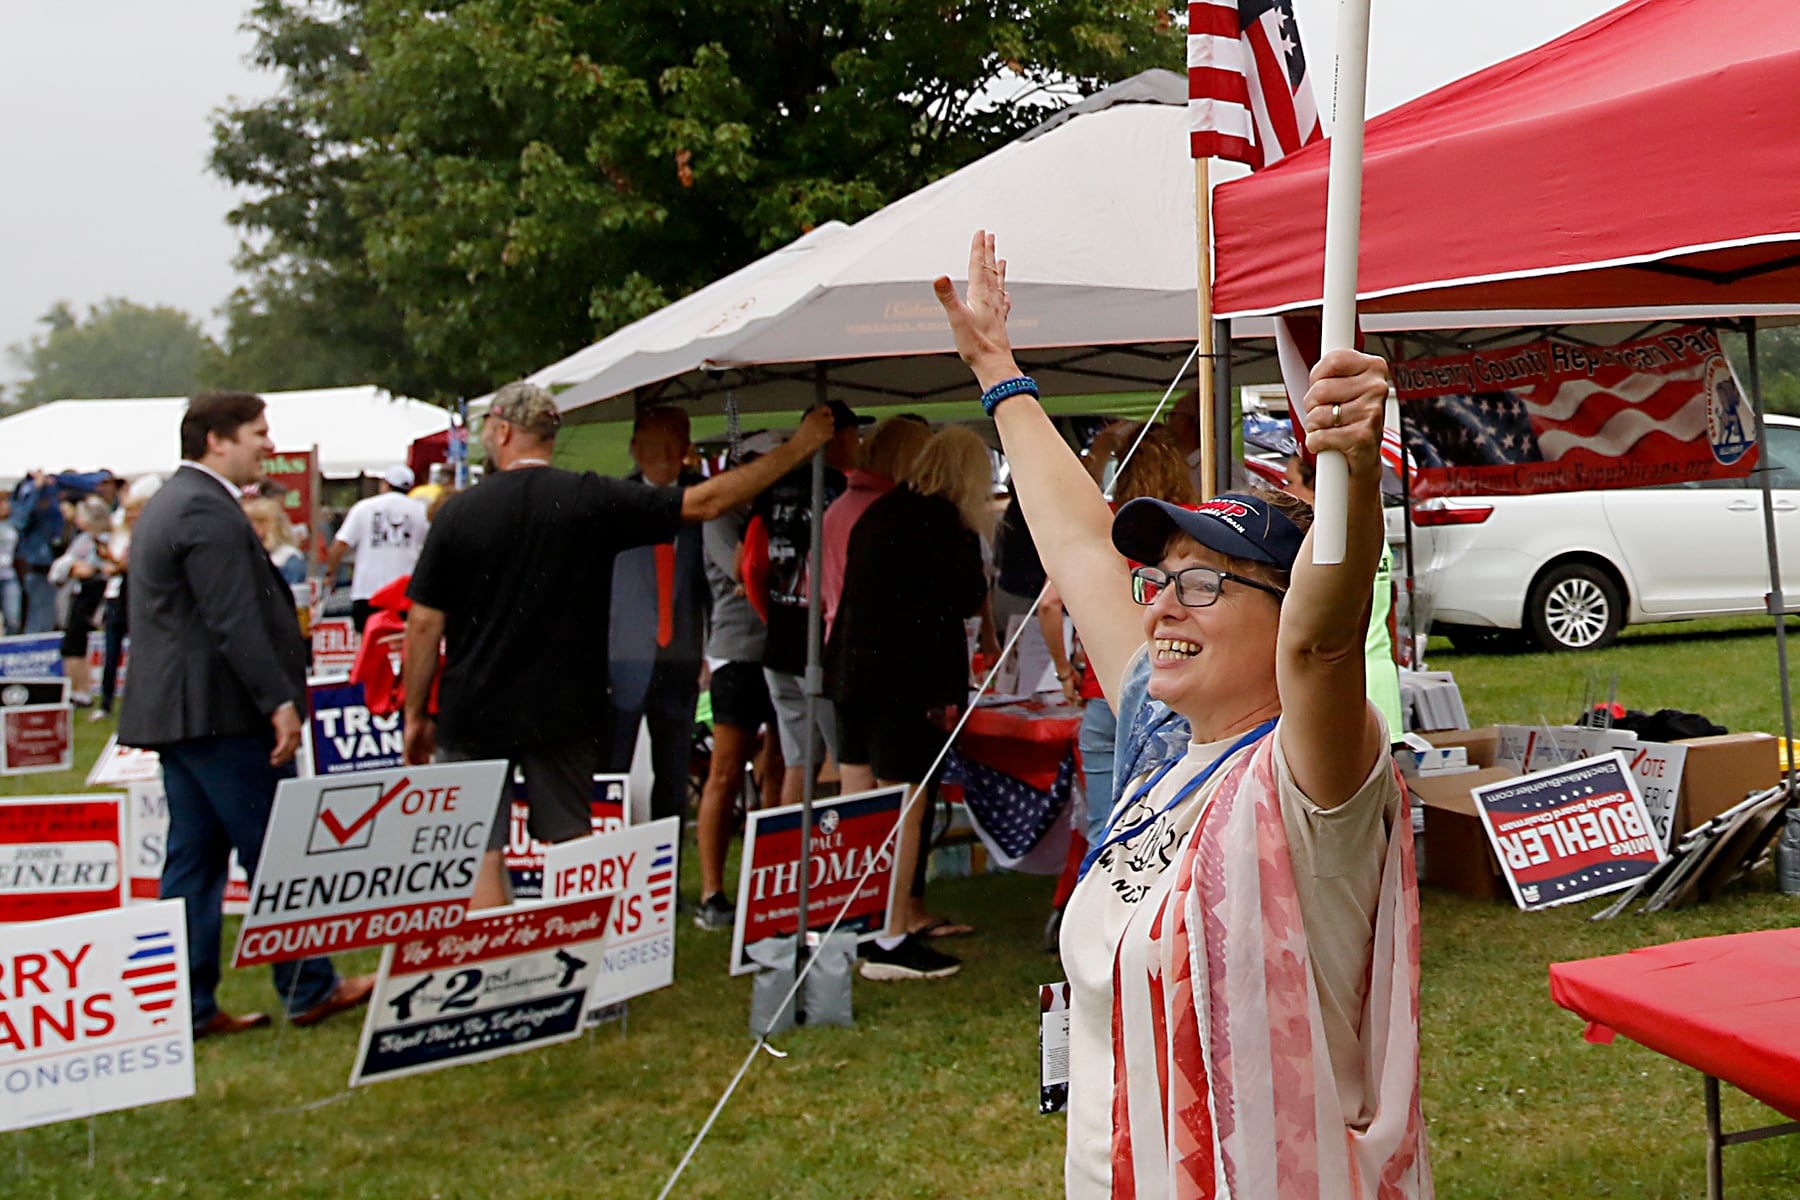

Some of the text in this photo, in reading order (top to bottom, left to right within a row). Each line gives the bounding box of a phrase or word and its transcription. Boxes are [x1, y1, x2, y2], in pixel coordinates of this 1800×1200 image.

[1474, 349, 1550, 383] County
[1486, 762, 1618, 803] ElectMikeBuehler.com
[1498, 792, 1626, 832] County Board Chairman
[411, 821, 485, 854] ERIC
[809, 832, 845, 853] PAUL
[1498, 802, 1648, 870] BUEHLER
[1610, 836, 1653, 856] Mike
[253, 856, 476, 916] HENDRICKS
[750, 839, 896, 901] THOMAS
[240, 903, 465, 958] COUNTY BOARD
[436, 931, 490, 964] Right
[512, 921, 541, 946] the
[544, 910, 602, 937] People
[604, 937, 671, 973] NGRESS
[4, 1039, 185, 1094] ONGRESS
